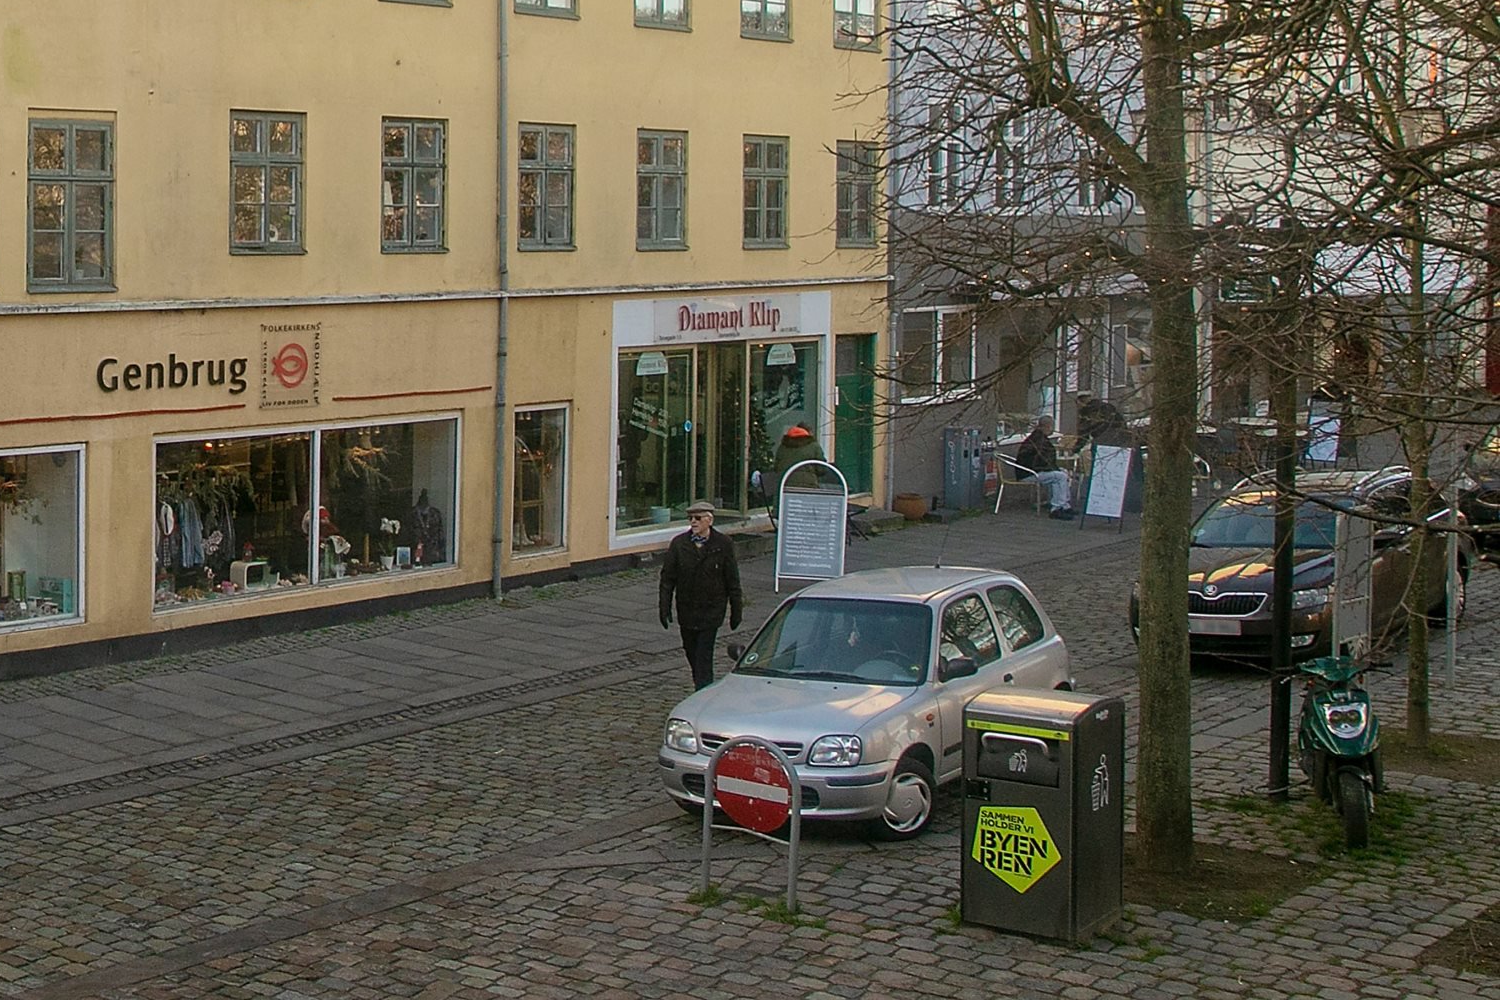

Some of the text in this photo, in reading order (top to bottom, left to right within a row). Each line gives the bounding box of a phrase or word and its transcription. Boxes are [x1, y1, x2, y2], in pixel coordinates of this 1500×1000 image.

[678, 300, 781, 333] Diamant Klip
[96, 353, 248, 395] Genbrug
[980, 810, 1025, 825] SAMMEN
[980, 818, 1034, 835] HOLDER VI
[980, 829, 1048, 859] BYEN
[980, 849, 1032, 876] REN
